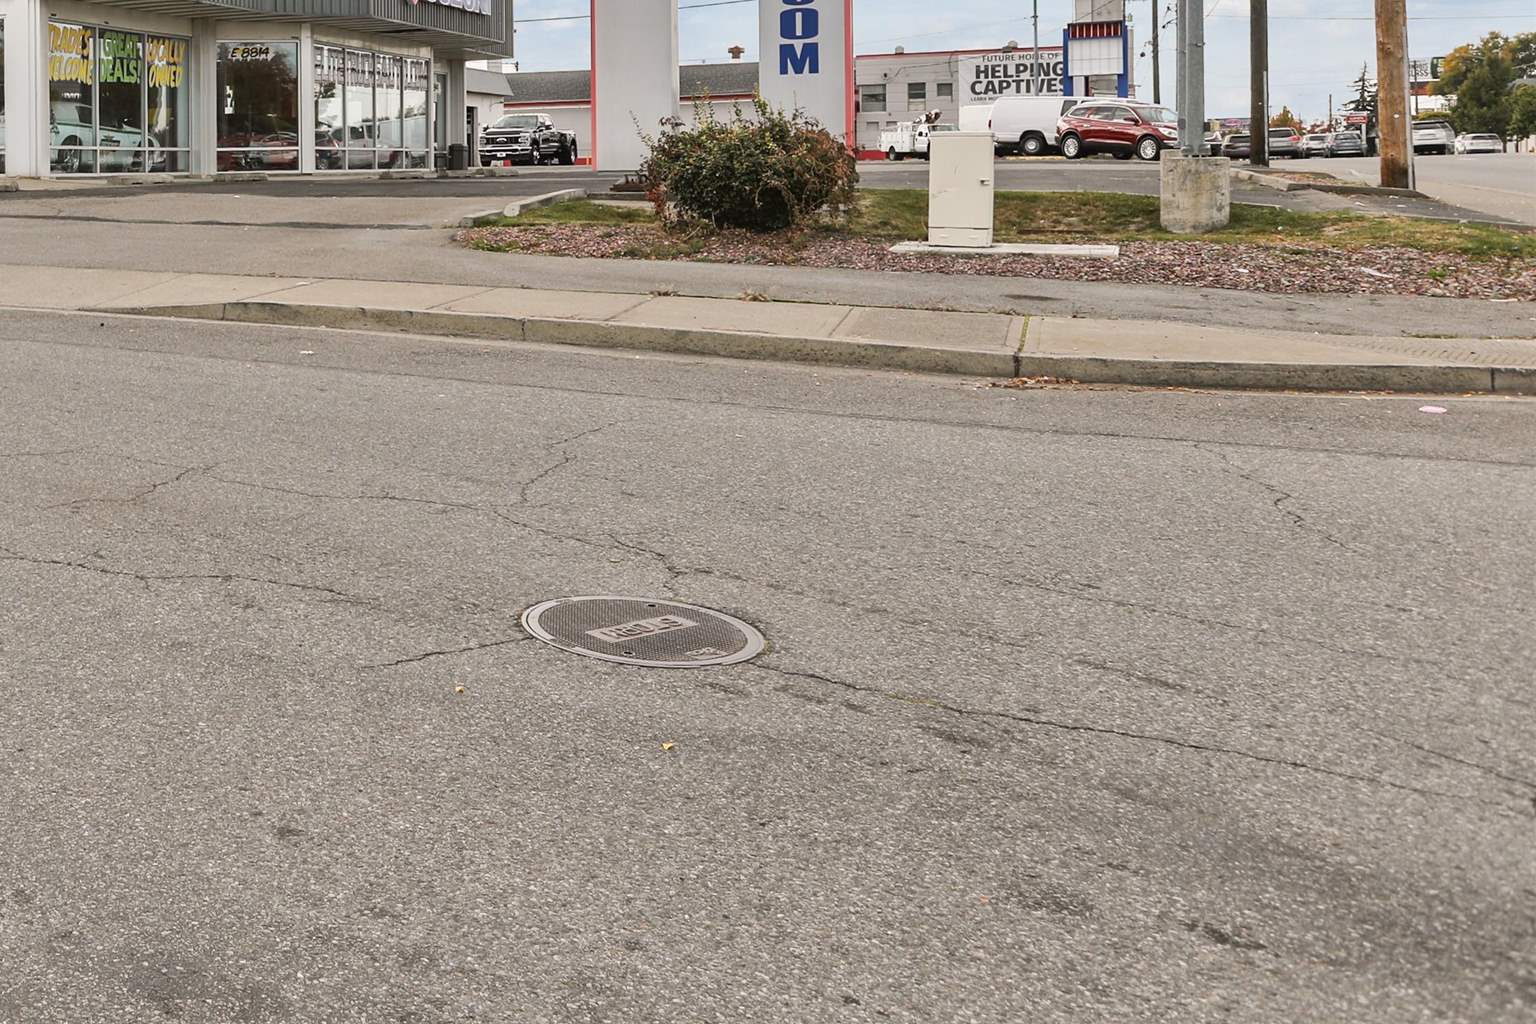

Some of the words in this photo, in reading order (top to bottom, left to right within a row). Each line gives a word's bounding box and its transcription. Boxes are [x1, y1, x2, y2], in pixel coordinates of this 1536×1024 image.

[104, 31, 138, 58] GREAT
[146, 37, 186, 64] LOCALLY
[241, 47, 270, 58] 8814
[983, 54, 1016, 62] FUTURE
[1048, 52, 1060, 60] OF
[99, 58, 142, 84] DEALS!
[149, 64, 183, 88] OWNED
[975, 61, 1064, 79] HELPING
